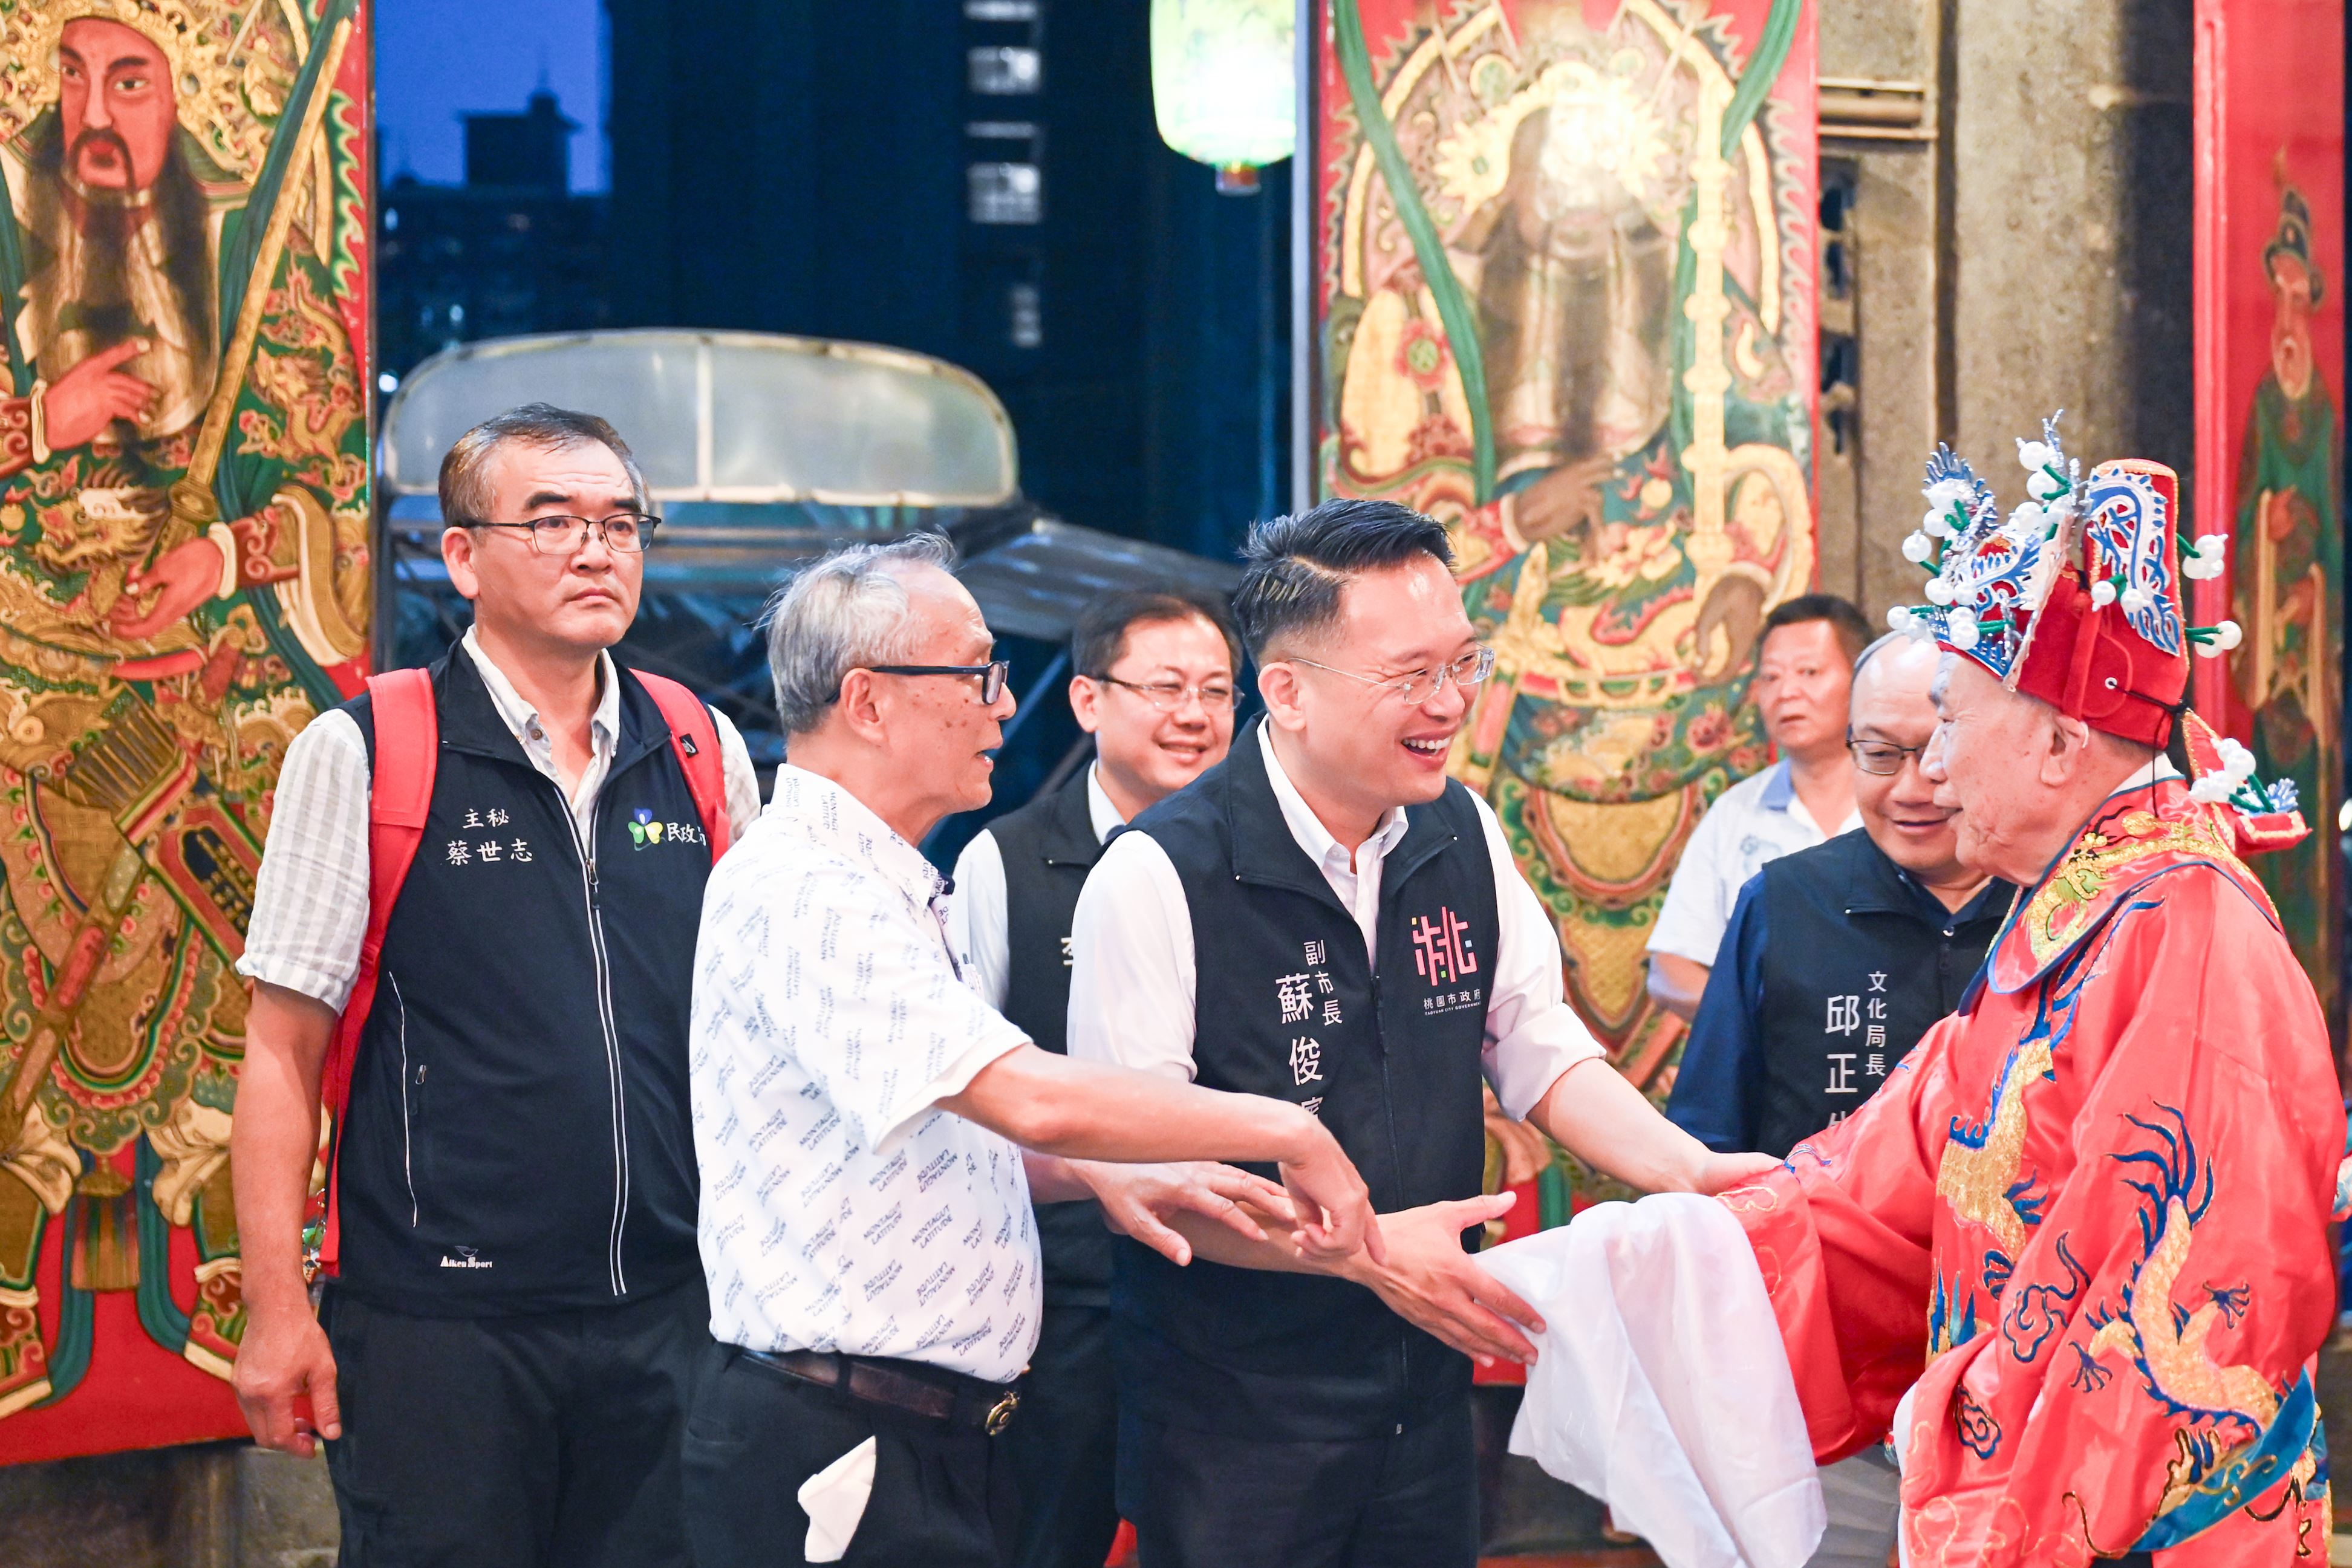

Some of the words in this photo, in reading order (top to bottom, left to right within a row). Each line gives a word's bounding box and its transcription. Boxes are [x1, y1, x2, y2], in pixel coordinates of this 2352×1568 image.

[462, 808, 509, 828] 主秘
[821, 794, 830, 830] LATITUD
[446, 838, 533, 866] 蔡世志
[1303, 940, 1343, 1026] 副市長
[1424, 989, 1481, 1010] 桃園市政府
[1865, 971, 1888, 1077] 文化局長
[869, 1148, 905, 1186] MONTAGUT
[916, 1148, 950, 1183] LATITUDE
[919, 1153, 957, 1193] MONTAGUT
[864, 1200, 901, 1239] MONTAGUT
[871, 1209, 902, 1246] LATITUDE
[911, 1204, 950, 1244] MONTAGUT
[919, 1212, 954, 1249] LATITUDE
[467, 1257, 493, 1269] Sport
[863, 1259, 896, 1292] LATITUDE
[916, 1261, 948, 1296] LATITUDE
[866, 1263, 903, 1303] MONTAGUT
[919, 1265, 956, 1307] MONTAGUT
